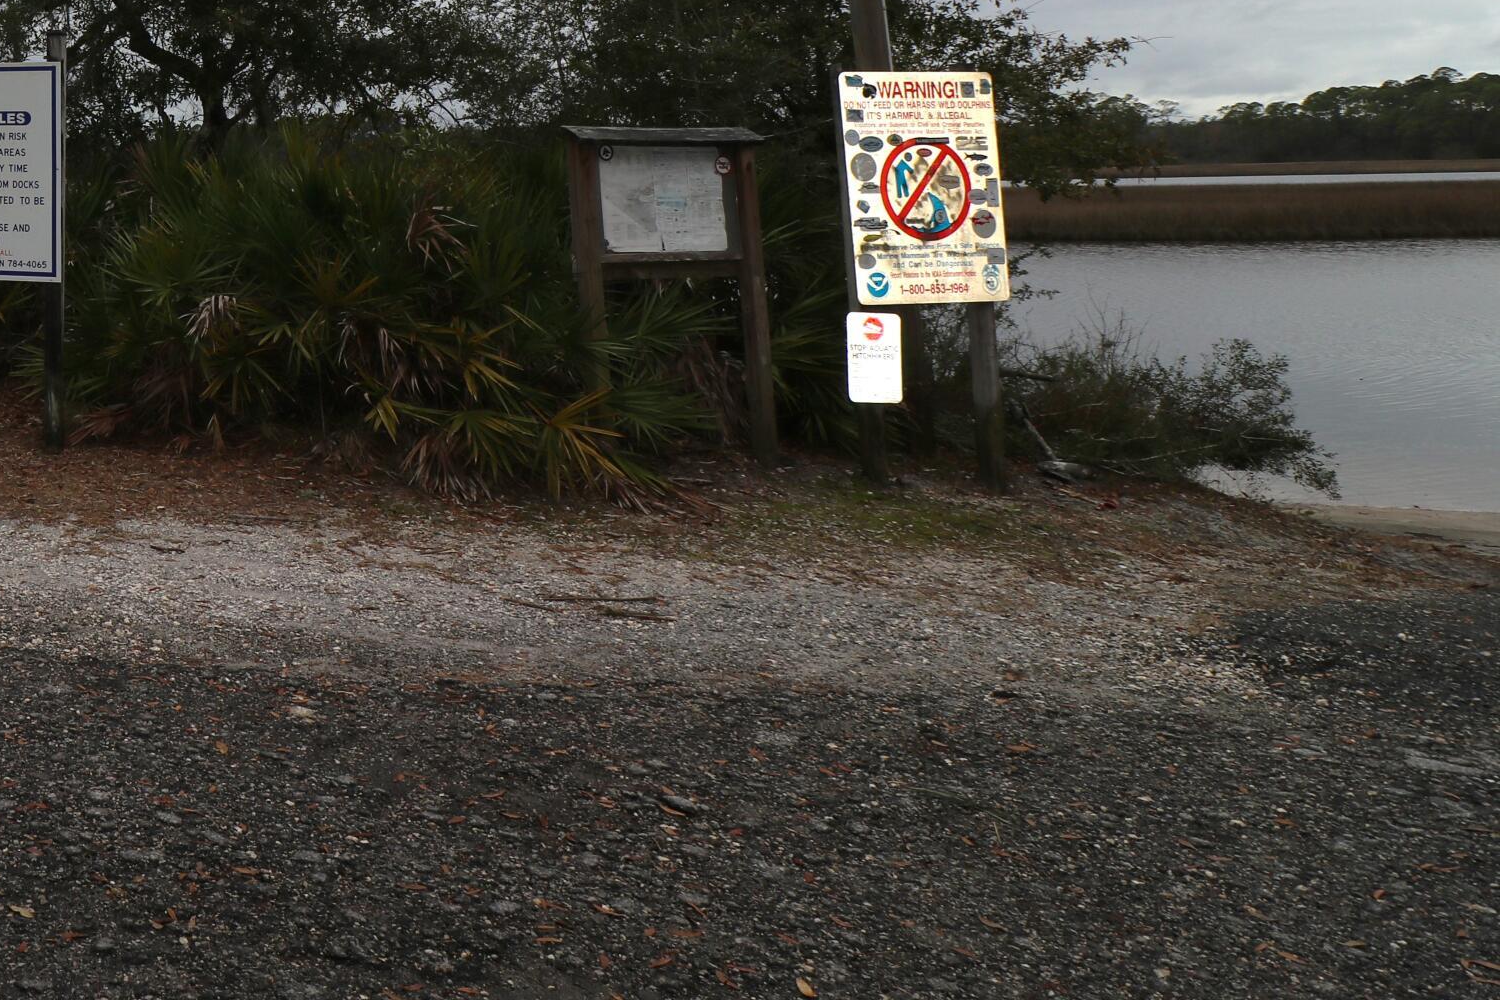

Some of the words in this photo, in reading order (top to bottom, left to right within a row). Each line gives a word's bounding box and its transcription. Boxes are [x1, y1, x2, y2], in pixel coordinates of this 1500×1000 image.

[877, 81, 959, 98] WARNING!
[844, 101, 855, 109] DO
[893, 101, 905, 109] OR
[907, 101, 935, 109] HARASS
[938, 101, 955, 109] WILD
[866, 112, 881, 120] IT'S
[885, 112, 924, 120] HARMFUL
[928, 112, 933, 120] &
[8, 132, 27, 141] RISK
[9, 164, 28, 172] TIME
[12, 180, 40, 189] DOCKS
[20, 196, 30, 205] TO
[34, 196, 45, 205] BE
[12, 223, 30, 232] AND
[8, 260, 47, 268] 784-4065
[900, 283, 969, 294] 1-800-853-1964
